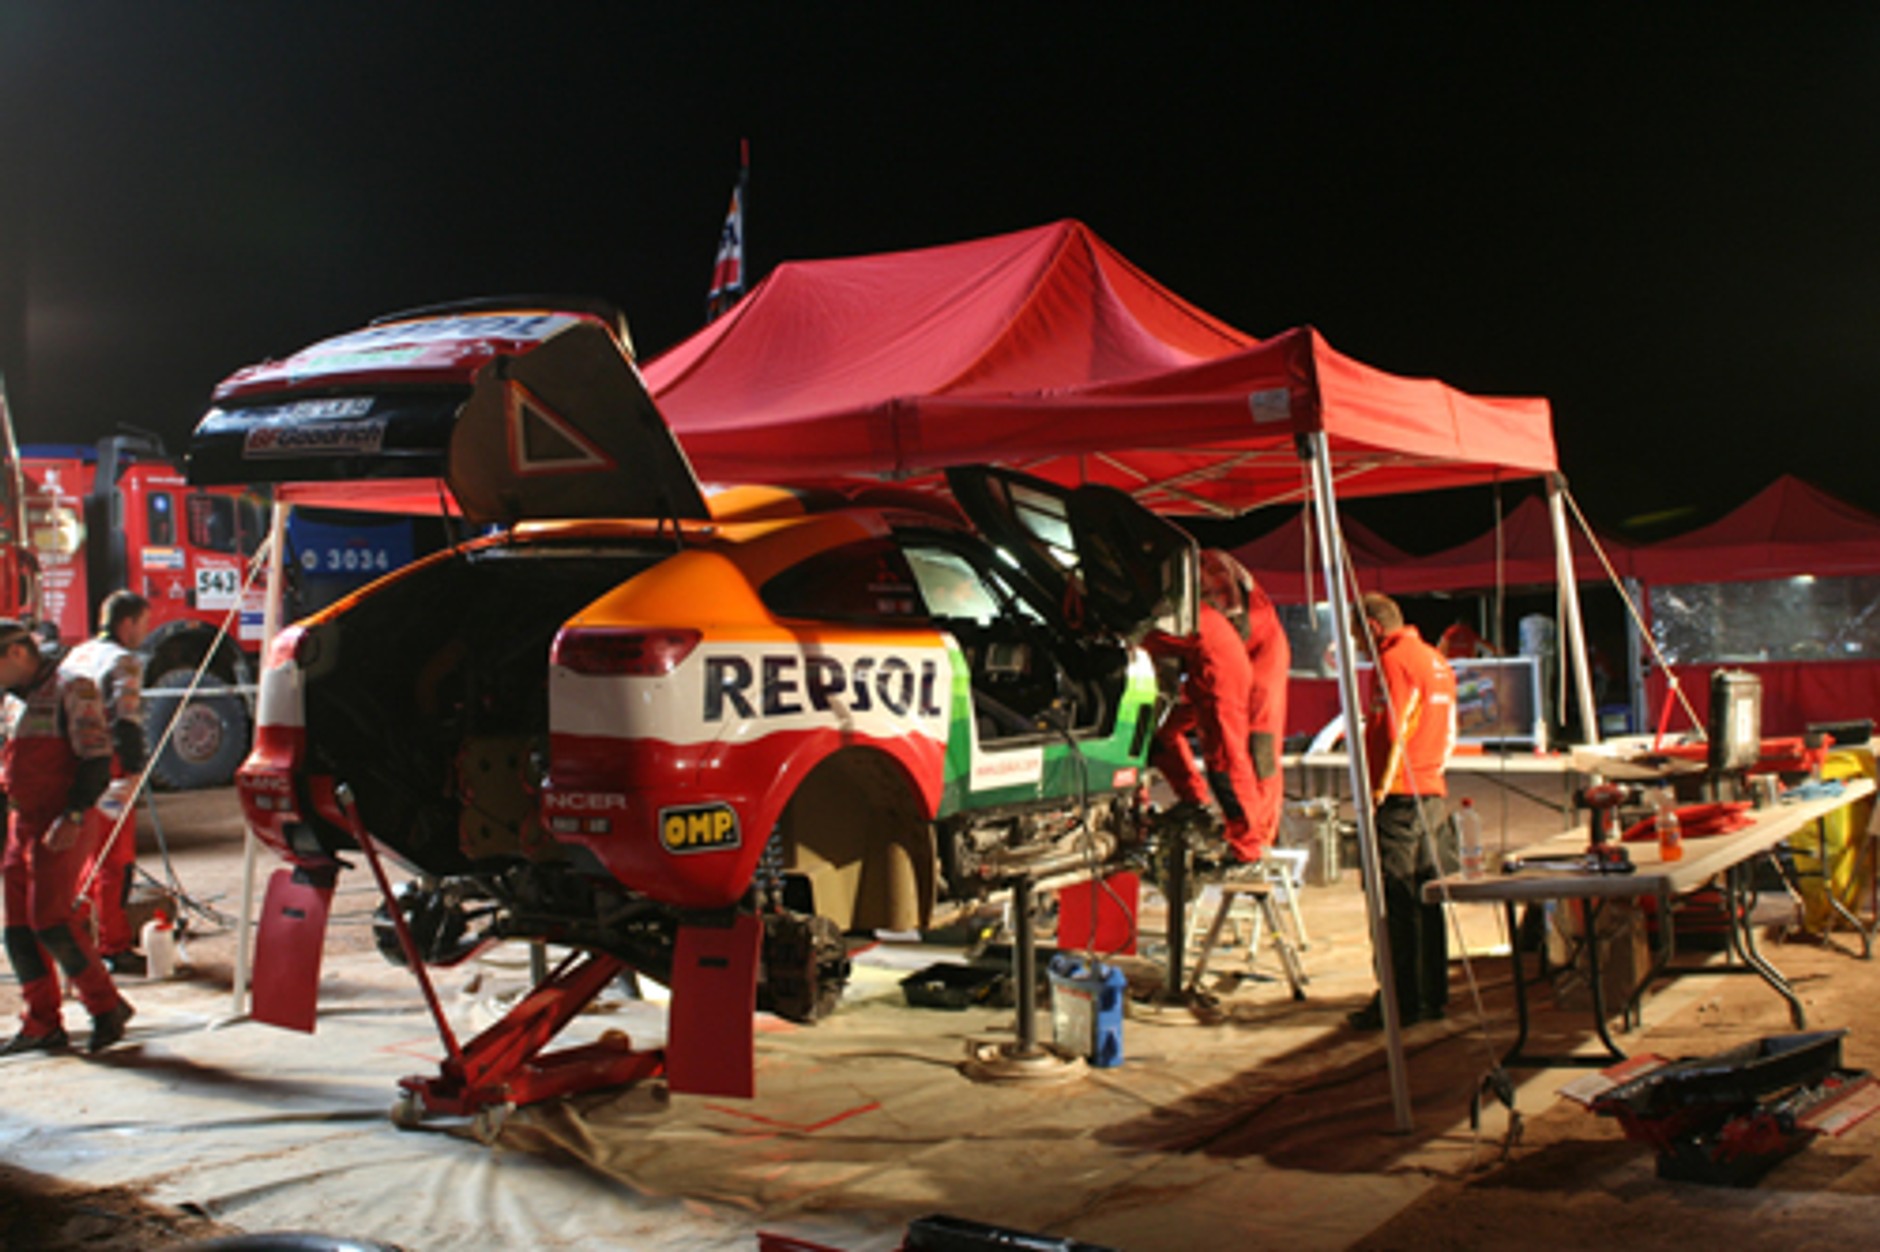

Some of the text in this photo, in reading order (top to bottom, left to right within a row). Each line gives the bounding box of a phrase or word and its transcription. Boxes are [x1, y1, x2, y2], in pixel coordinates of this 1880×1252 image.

[327, 549, 389, 571] 3034
[198, 571, 236, 595] 543
[703, 655, 941, 722] REPSOL
[665, 810, 732, 847] OMP
